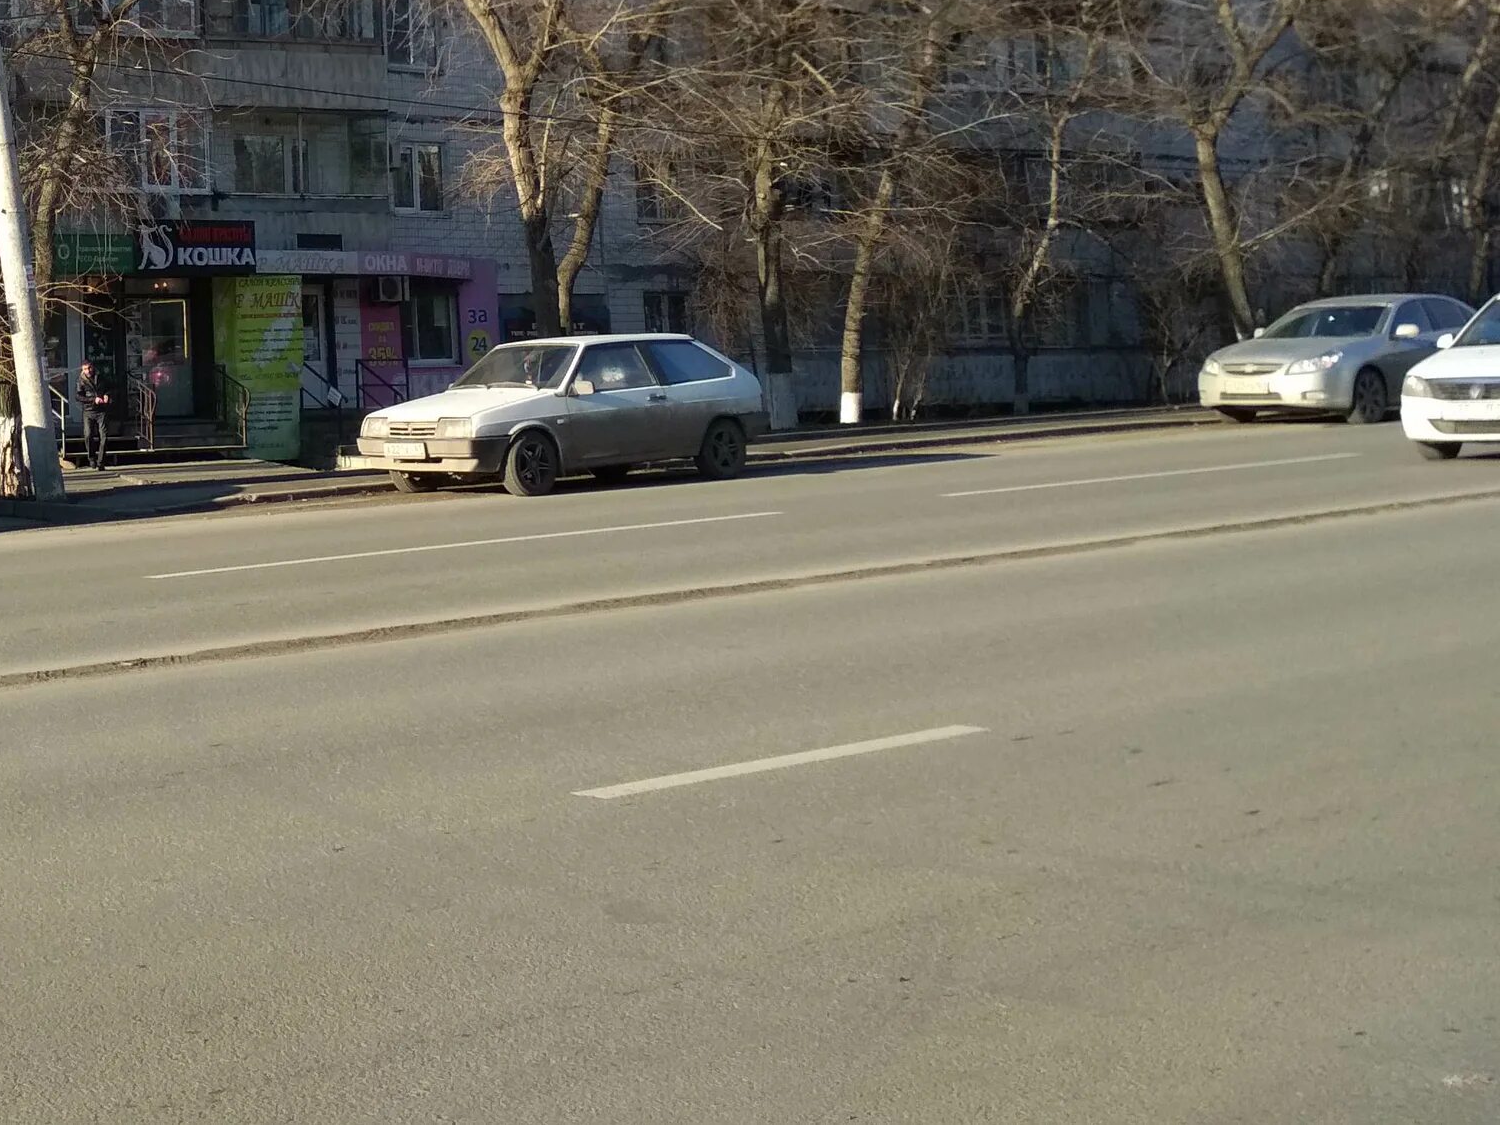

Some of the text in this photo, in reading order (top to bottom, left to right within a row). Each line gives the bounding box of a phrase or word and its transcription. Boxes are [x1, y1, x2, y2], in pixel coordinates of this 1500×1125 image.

[177, 247, 257, 266] КОШКА
[364, 255, 408, 272] ОКНА
[471, 336, 488, 351] 24
[368, 346, 399, 367] 35%
